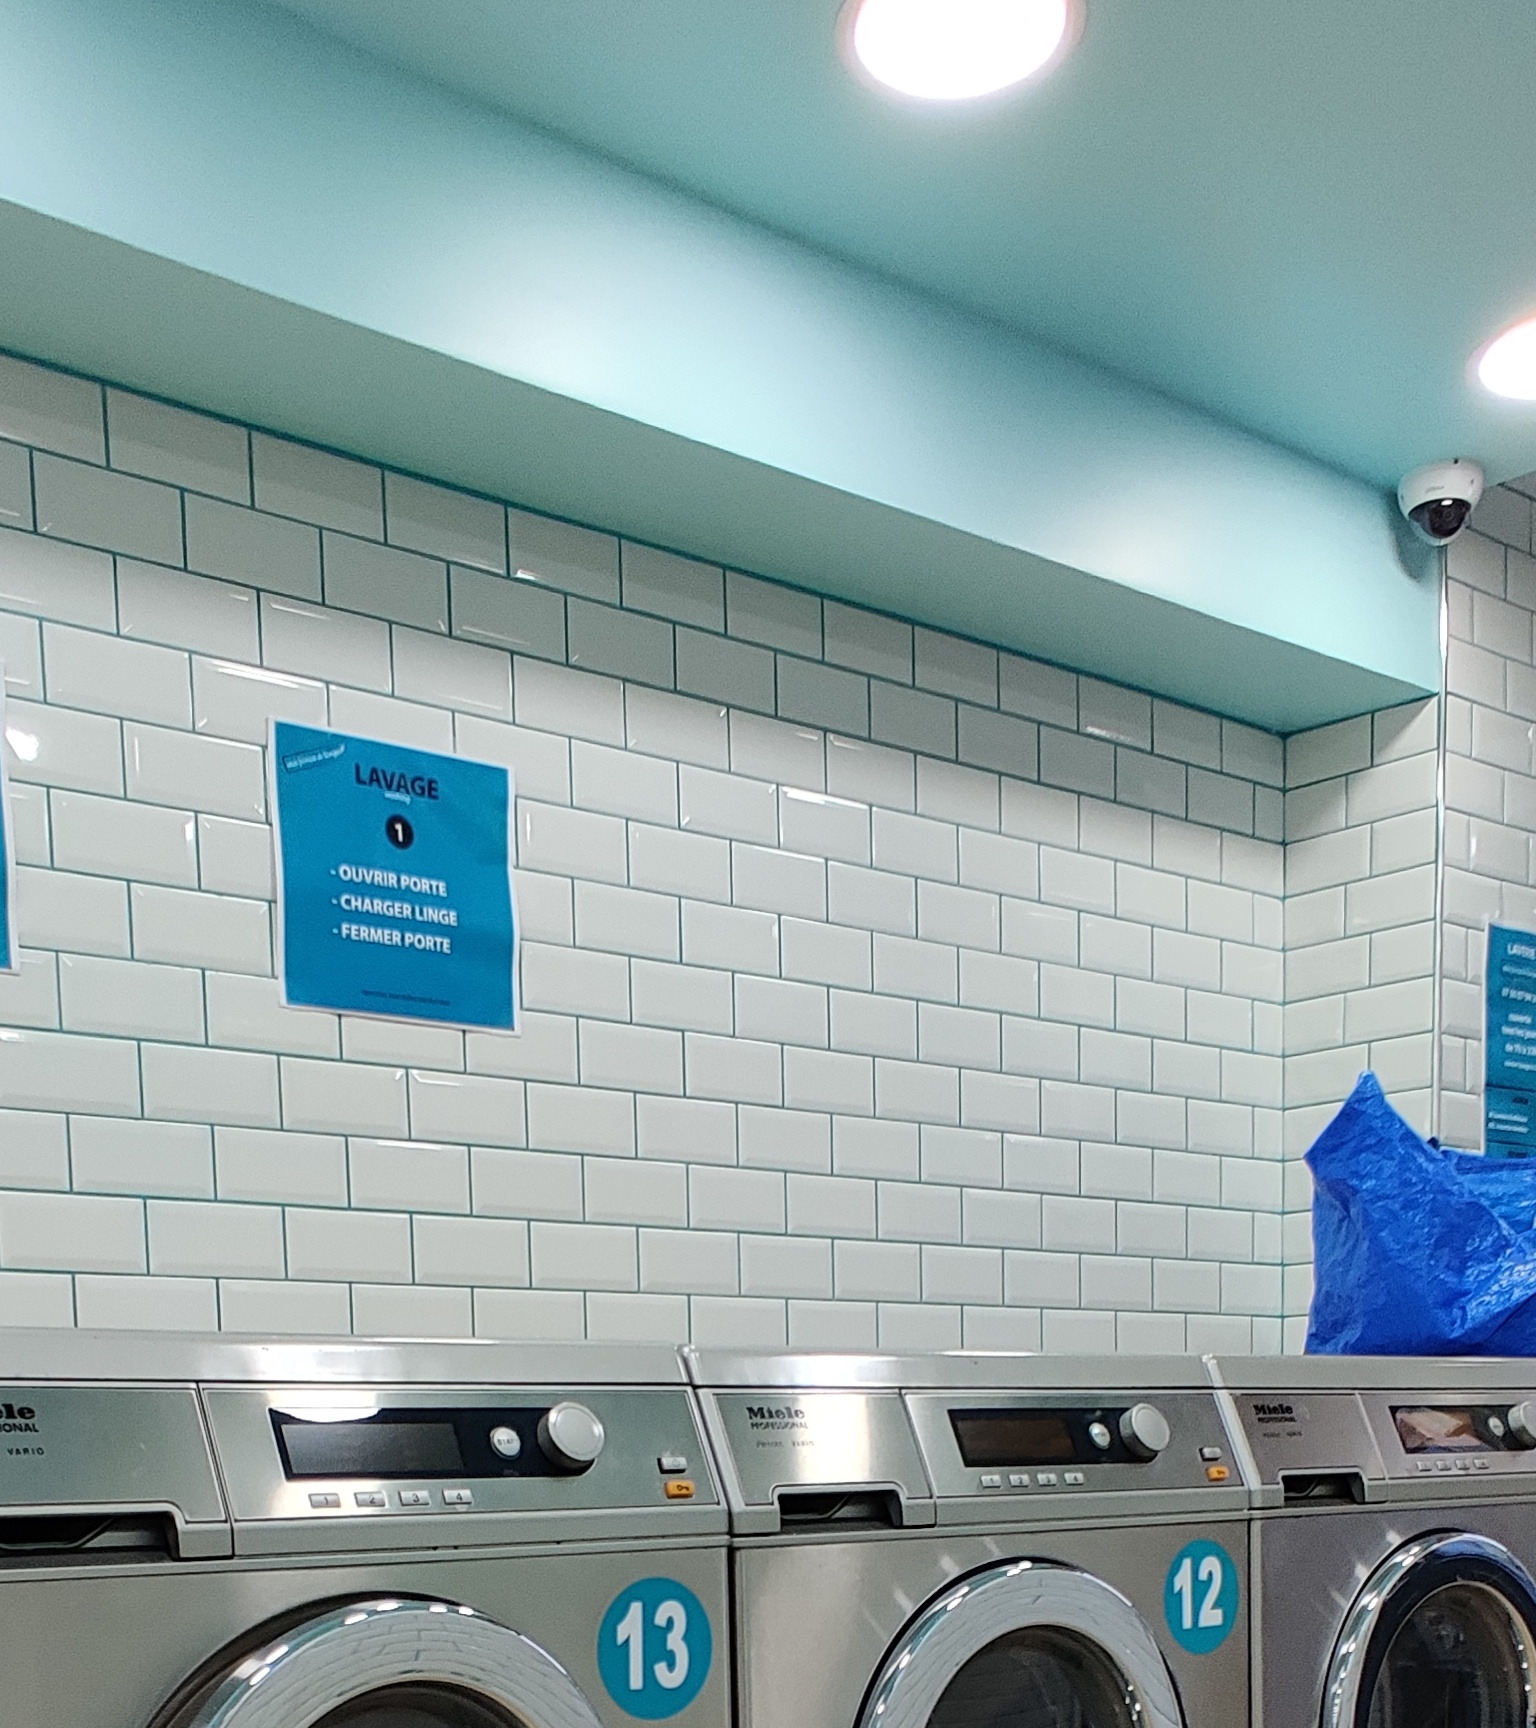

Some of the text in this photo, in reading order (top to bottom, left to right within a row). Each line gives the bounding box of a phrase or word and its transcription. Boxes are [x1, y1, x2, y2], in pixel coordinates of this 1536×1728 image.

[354, 763, 440, 800] LAVAGE
[394, 823, 404, 842] 1
[338, 863, 448, 898] OUVRIR PORTE
[340, 894, 458, 927] CHARGER LINGE
[341, 923, 452, 955] FERMER PORTE
[746, 1406, 805, 1419] Miele
[7, 1447, 45, 1456] VARIO
[1172, 1555, 1224, 1631] 12
[616, 1599, 691, 1692] 13
